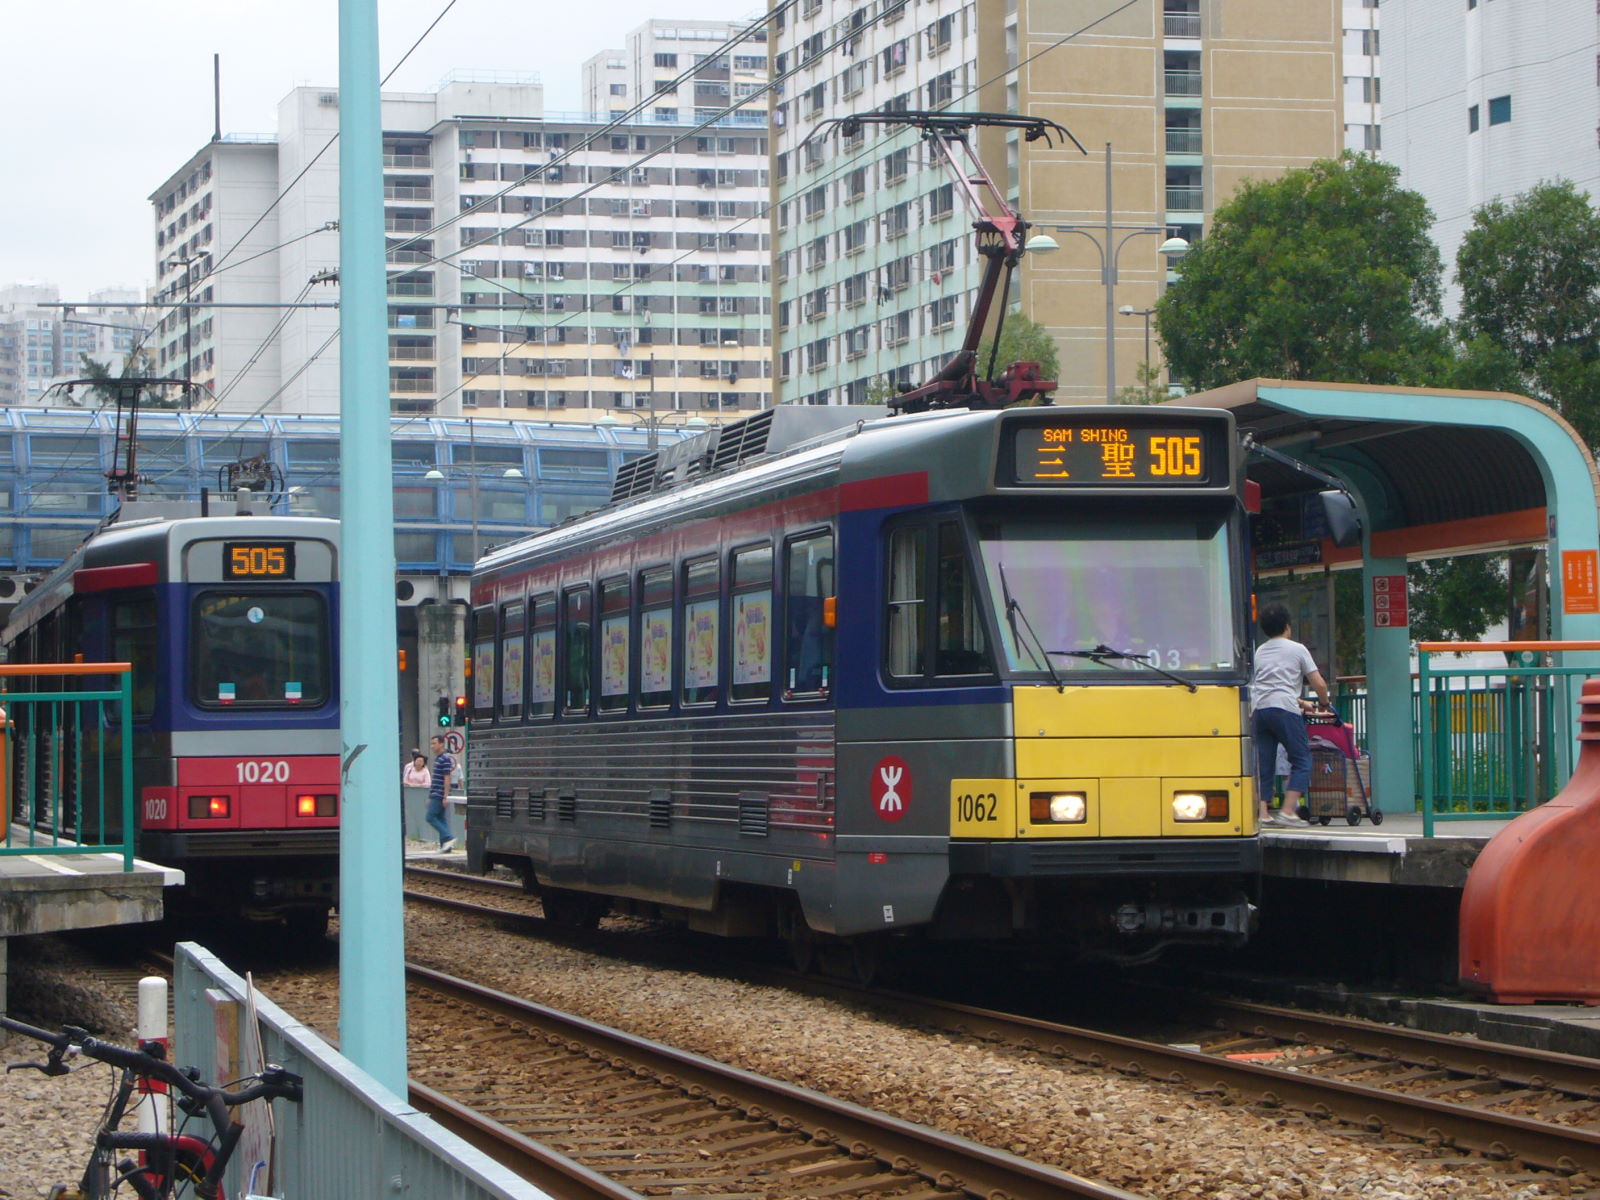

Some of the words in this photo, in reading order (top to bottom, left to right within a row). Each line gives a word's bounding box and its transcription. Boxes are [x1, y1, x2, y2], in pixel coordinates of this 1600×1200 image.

[1043, 429, 1072, 442] SAM
[1080, 429, 1128, 442] SHING
[1034, 443, 1136, 477] 三聖
[1150, 436, 1200, 476] 505
[232, 547, 285, 575] 505
[236, 761, 290, 783] 1020
[145, 798, 166, 820] 1020
[957, 793, 998, 822] 1062
